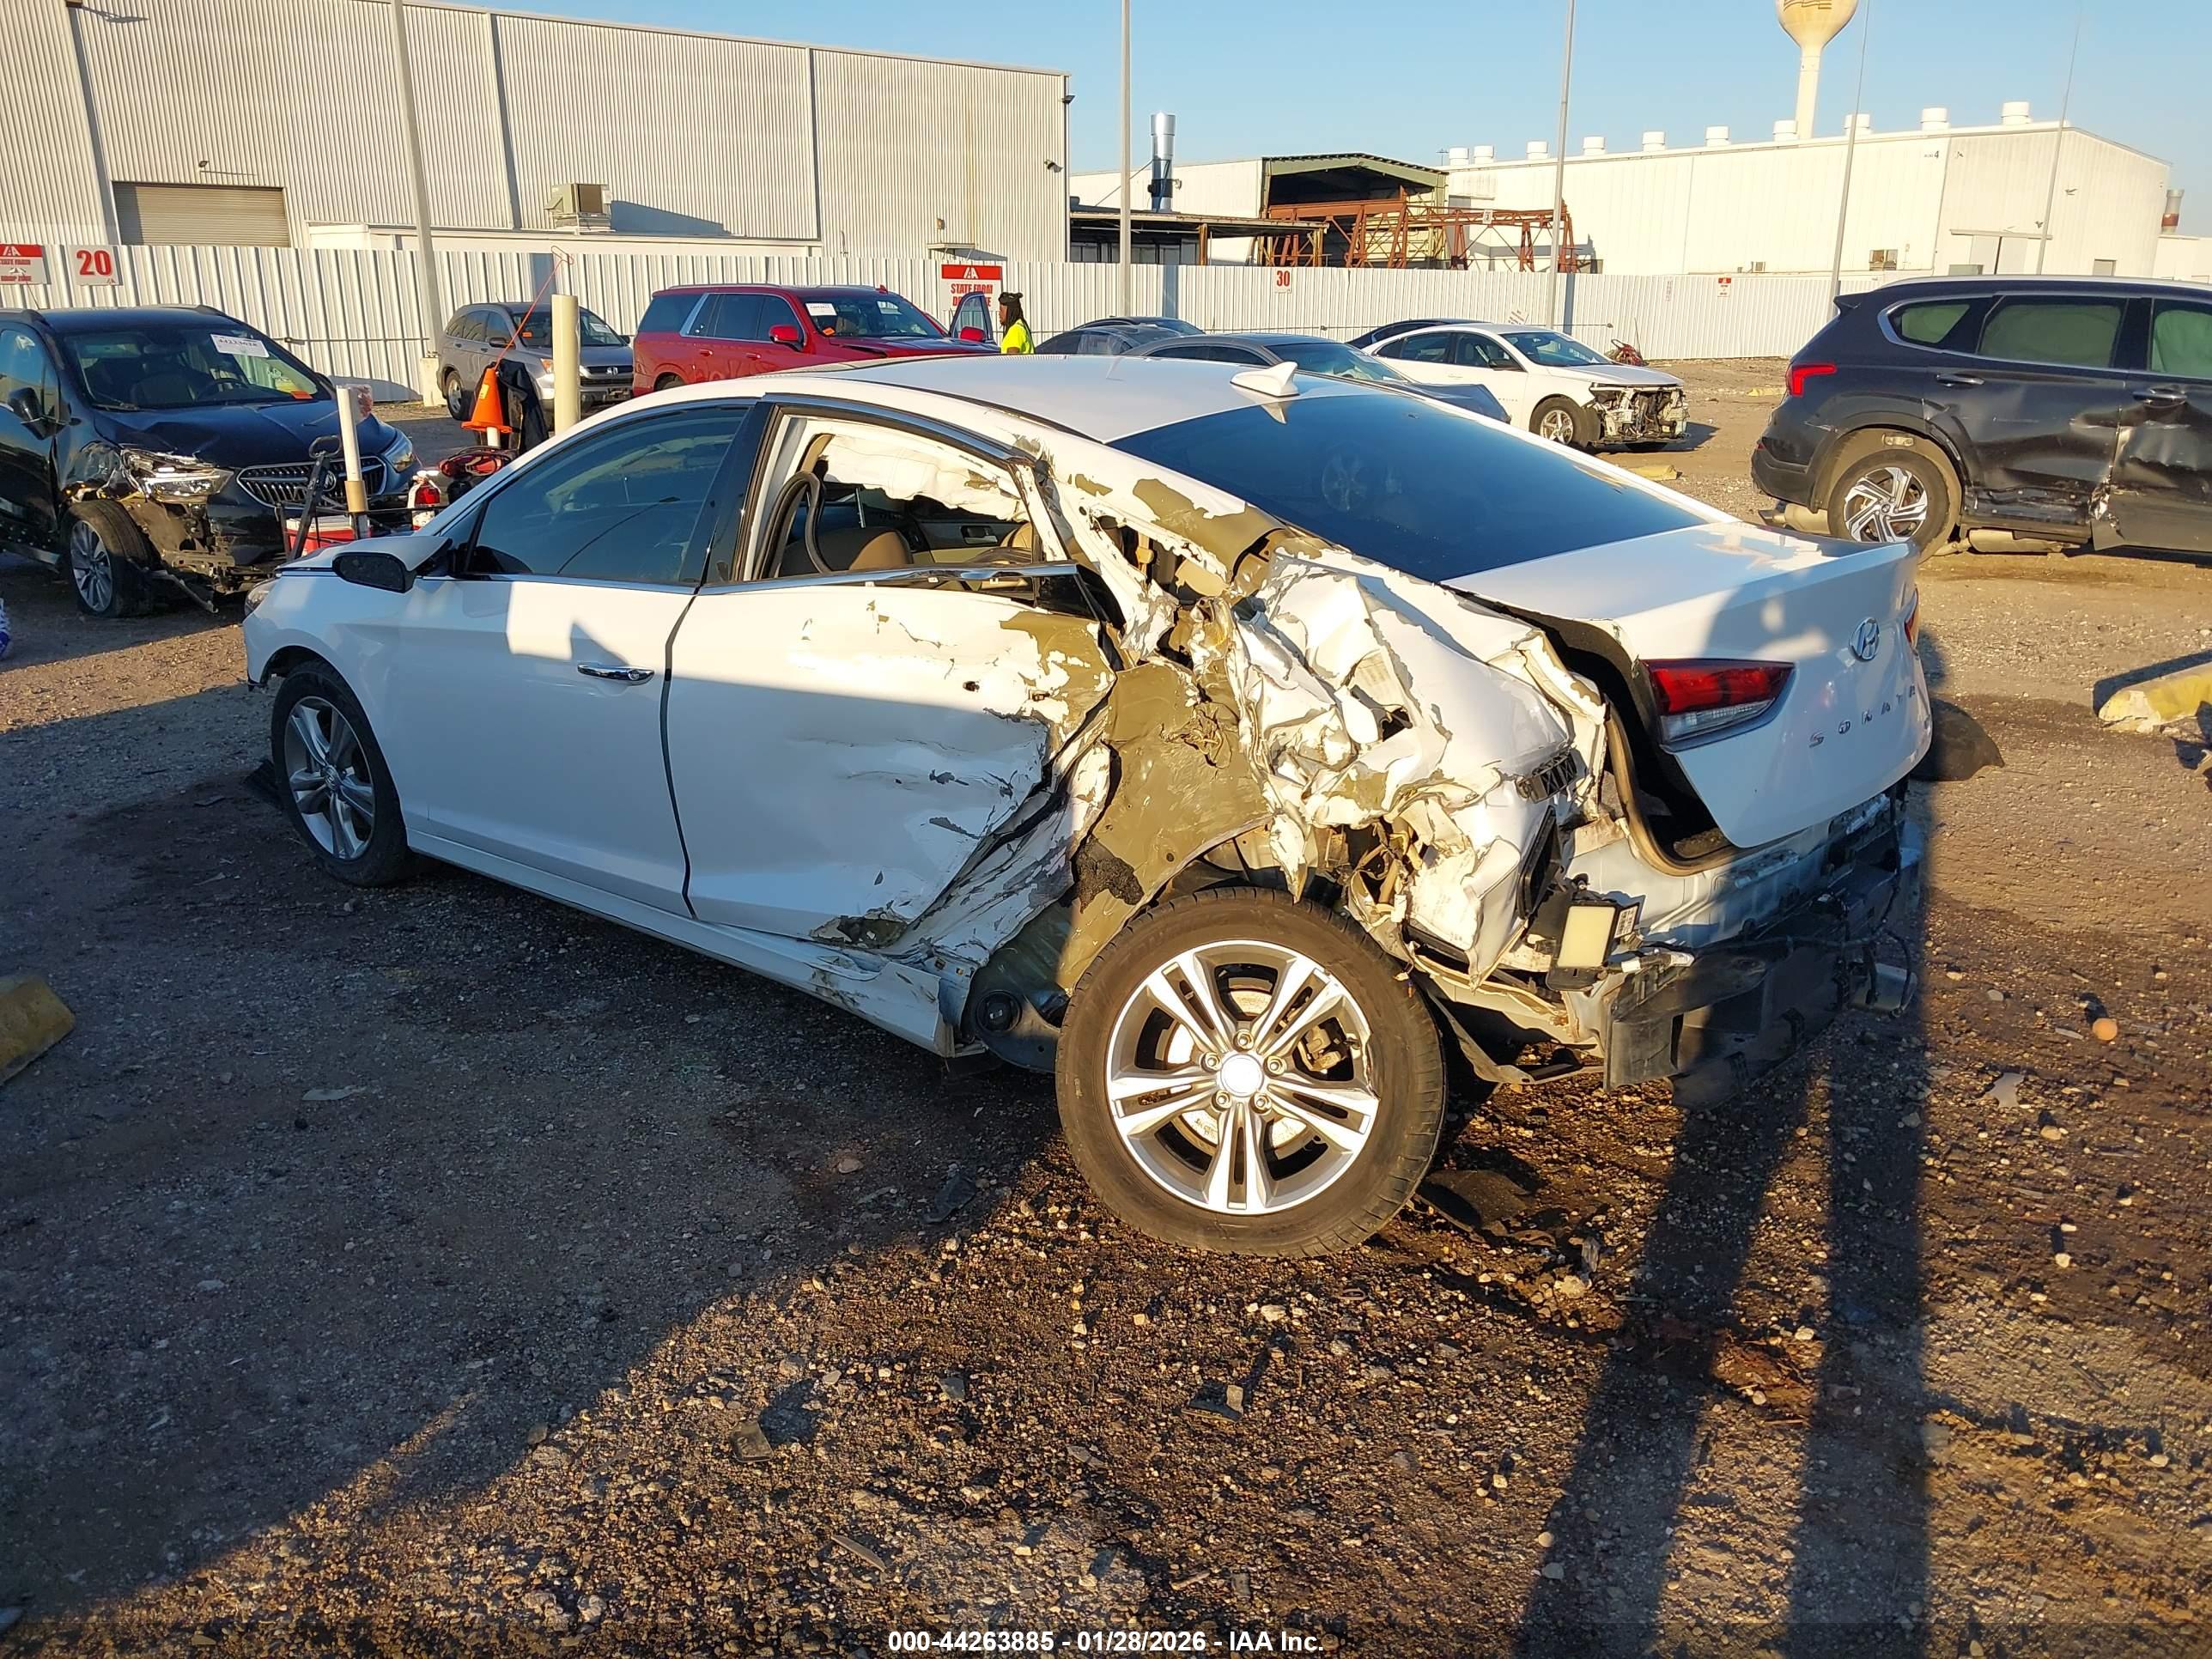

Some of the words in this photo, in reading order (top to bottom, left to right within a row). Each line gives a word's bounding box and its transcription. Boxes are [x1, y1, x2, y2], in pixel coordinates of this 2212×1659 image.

[76, 250, 111, 275] 20
[1276, 270, 1290, 286] 30
[951, 283, 972, 294] STATE
[974, 283, 993, 294] FARM
[1808, 685, 1916, 748] SONATA
